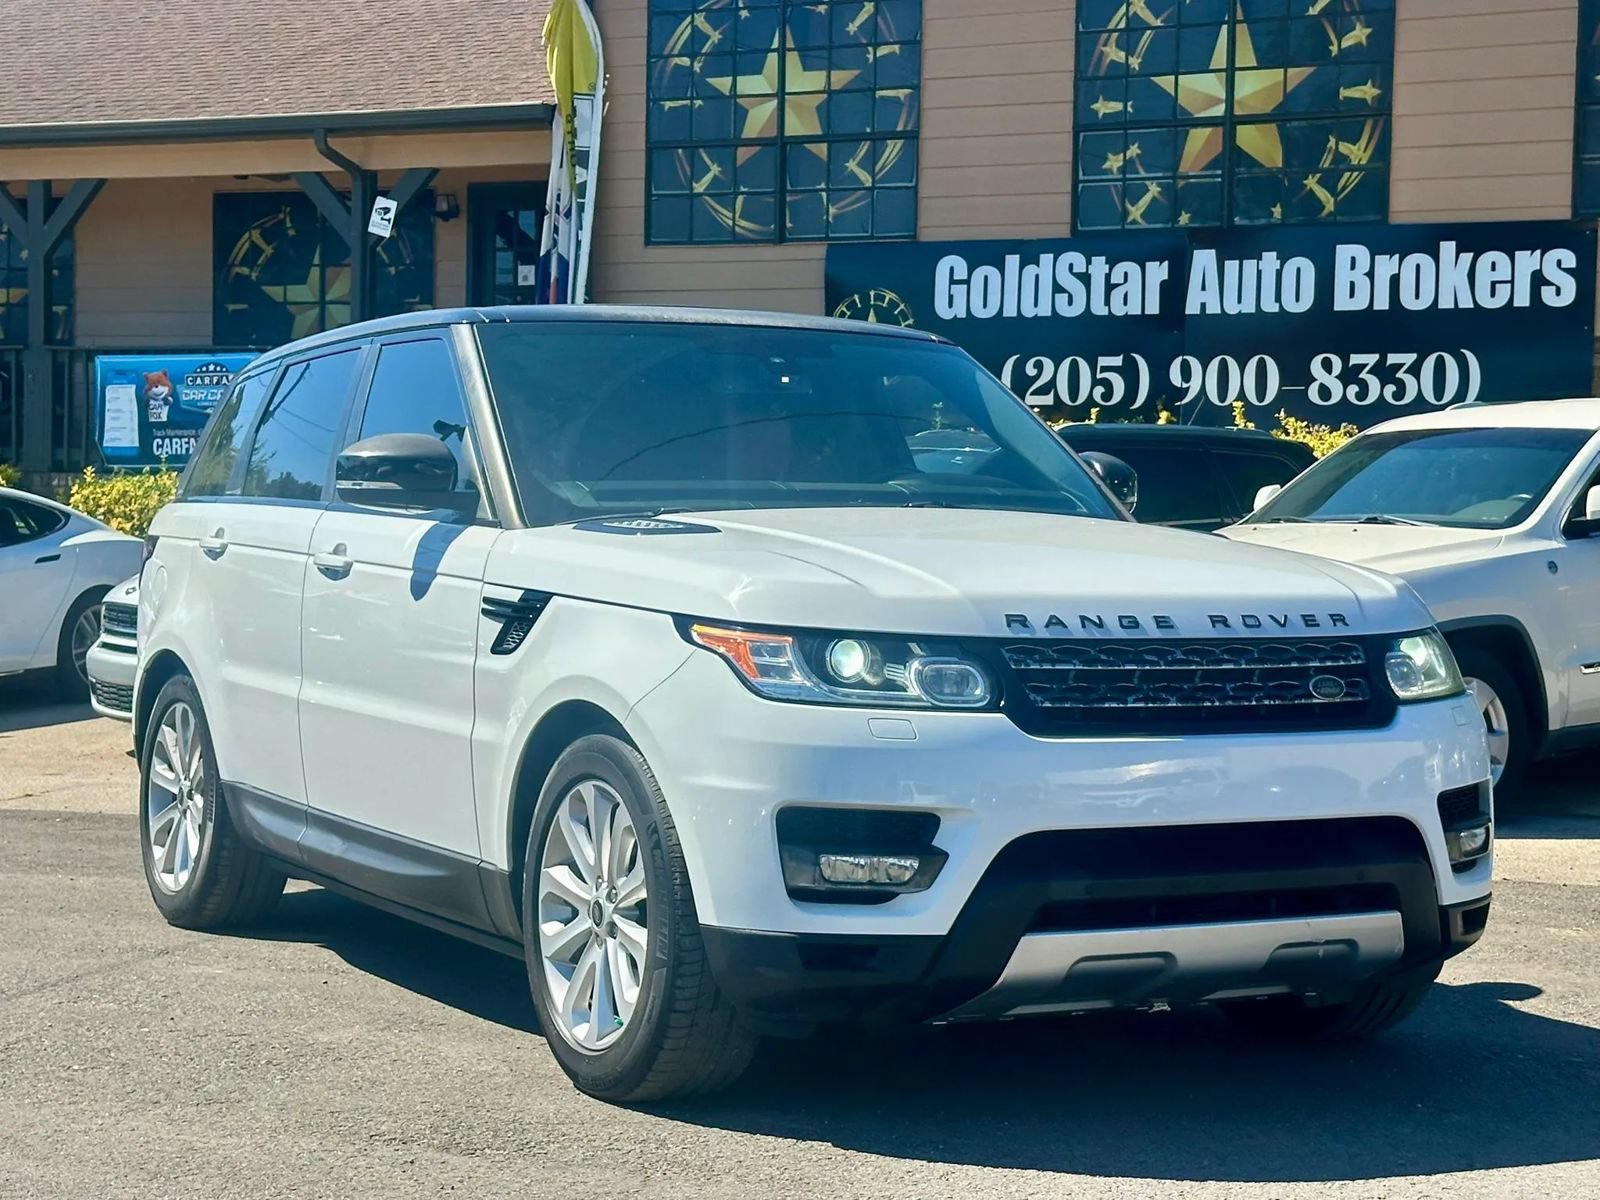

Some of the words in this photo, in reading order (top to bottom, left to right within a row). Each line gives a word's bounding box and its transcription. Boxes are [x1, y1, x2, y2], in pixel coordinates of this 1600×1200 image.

[934, 251, 1169, 320] GoldStar
[1185, 248, 1316, 315] Auto
[1333, 240, 1577, 311] Brokers
[187, 376, 231, 386] CARFA
[1000, 353, 1150, 410] (205)
[153, 438, 196, 455] CARFA
[1004, 613, 1176, 630] RANGE
[1207, 613, 1350, 629] ROVER
